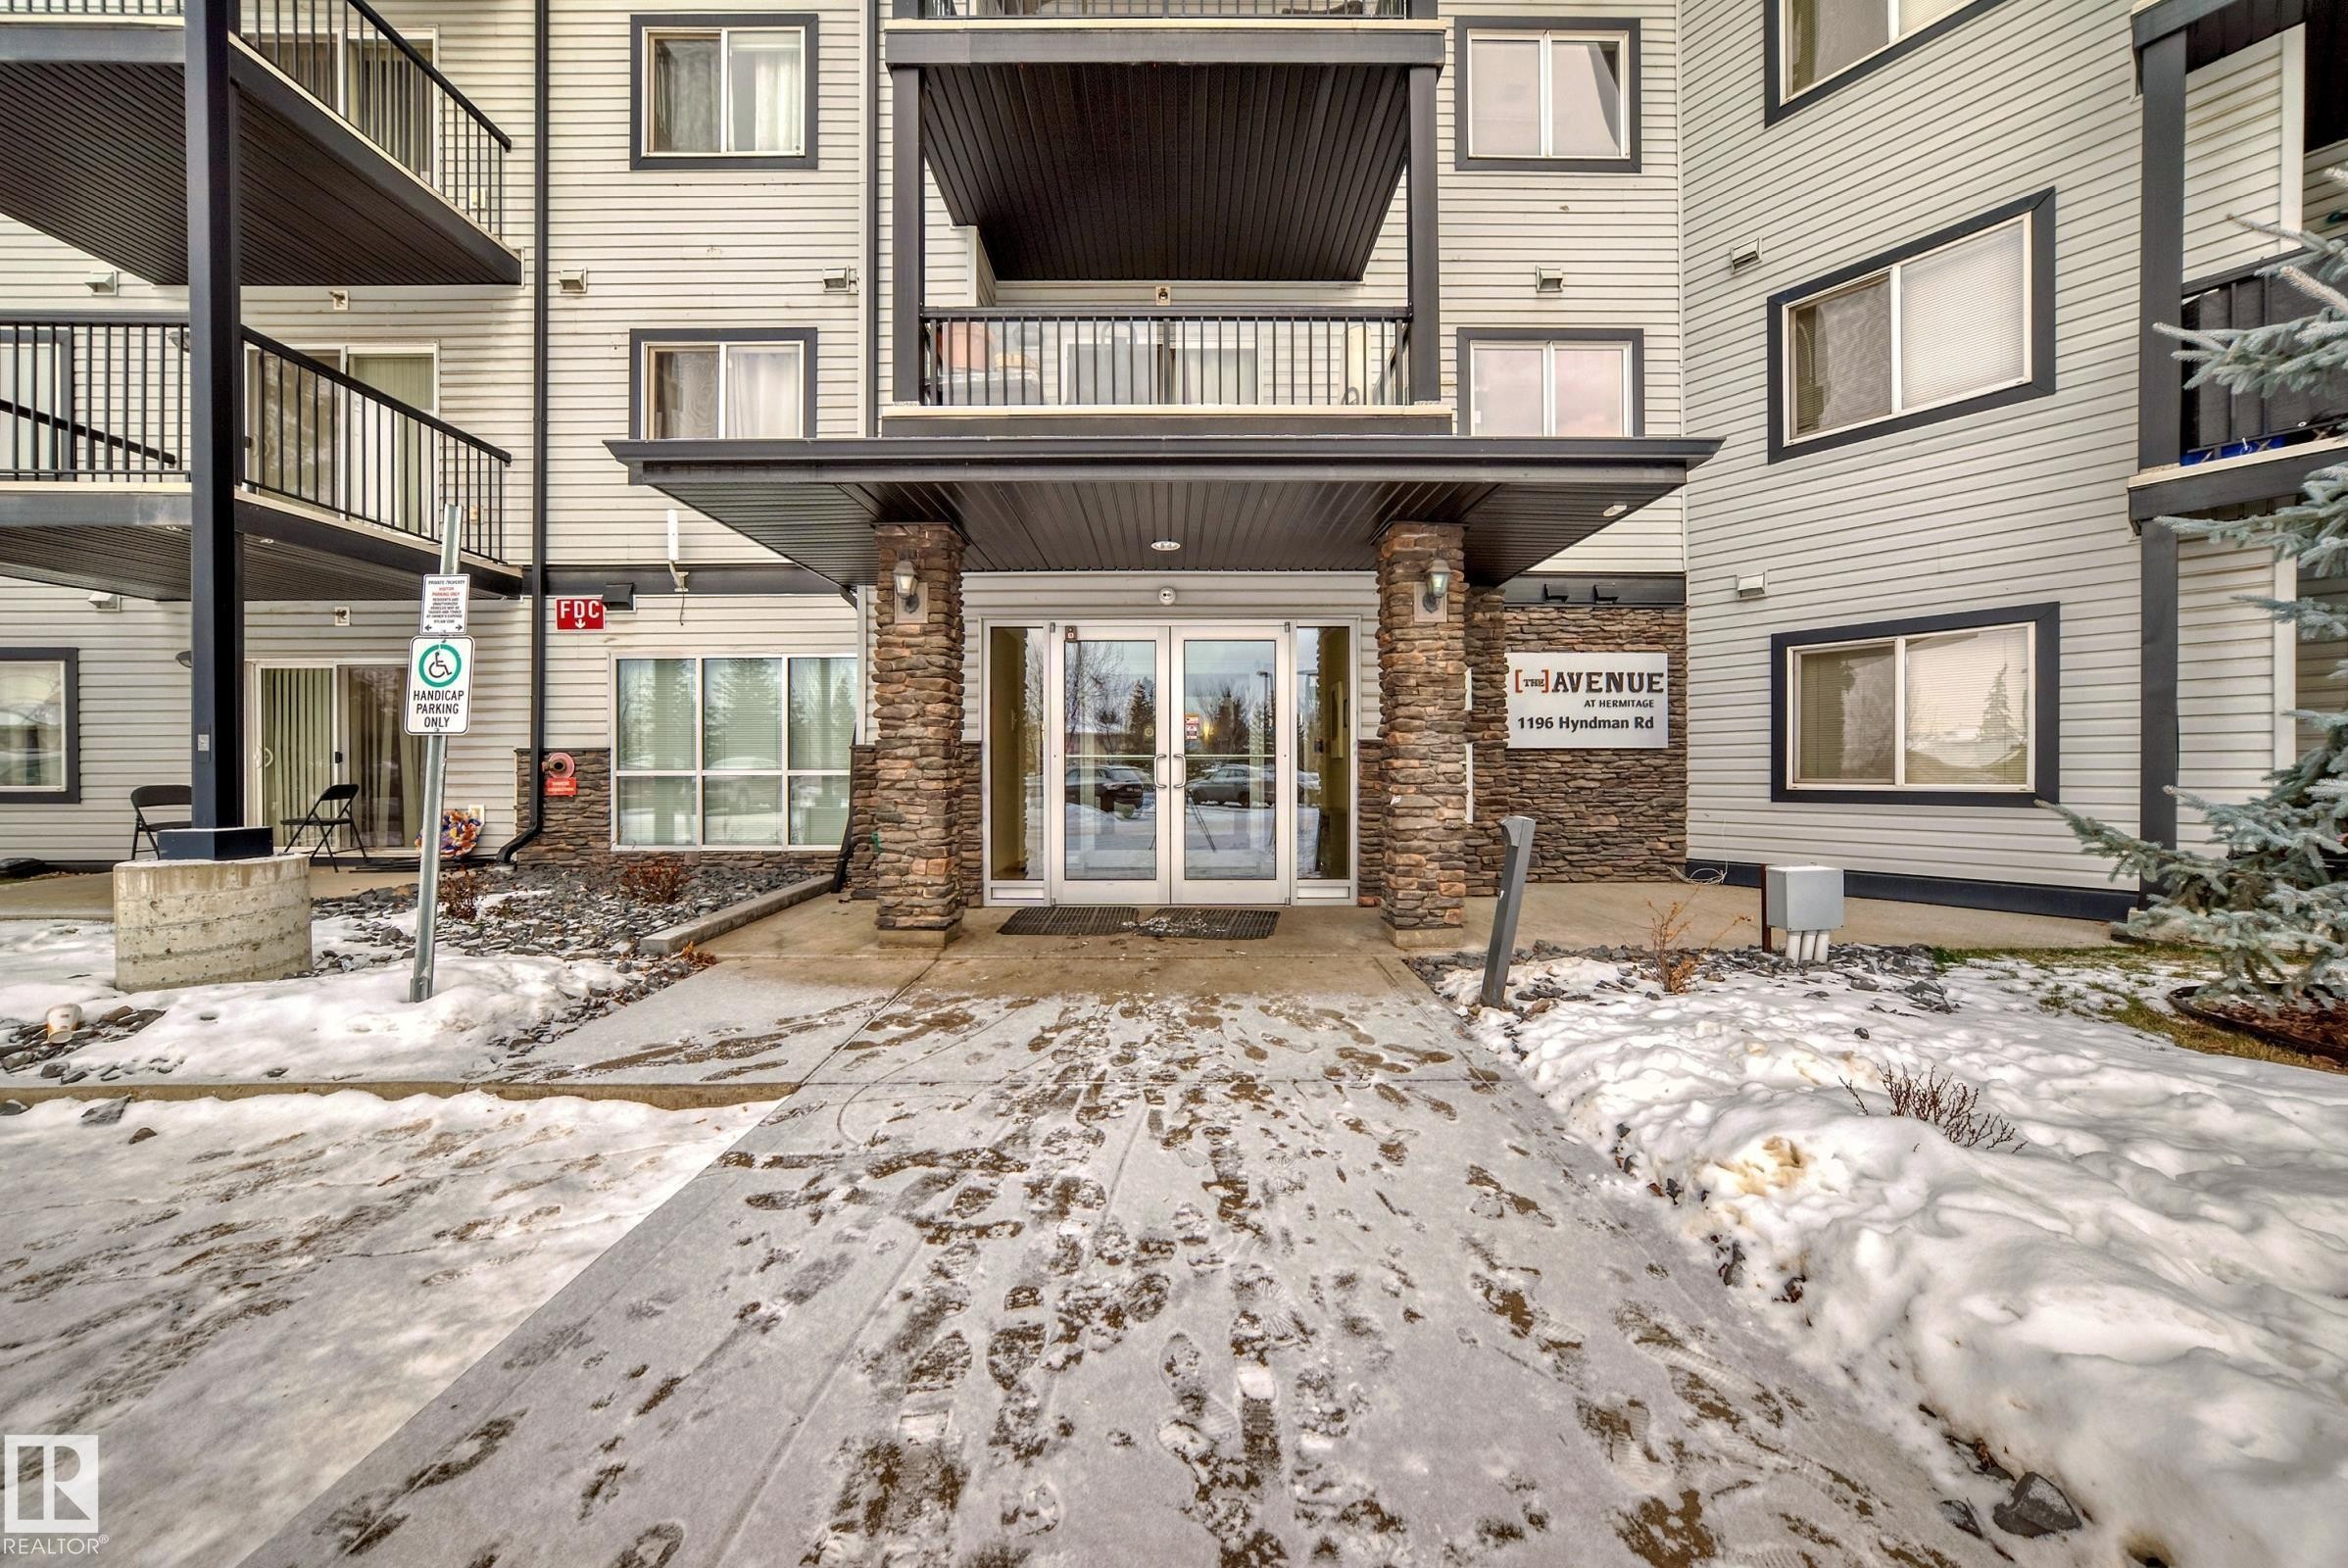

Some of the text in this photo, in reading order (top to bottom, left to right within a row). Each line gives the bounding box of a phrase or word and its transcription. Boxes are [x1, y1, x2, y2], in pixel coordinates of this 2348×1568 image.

[561, 600, 600, 619] FDC
[1551, 671, 1664, 693] AVENUE
[414, 690, 465, 701] HANDICAP
[416, 703, 459, 714] PARKING
[424, 716, 451, 728] ONLY
[1518, 716, 1654, 732] 1196 Hyndman Rd
